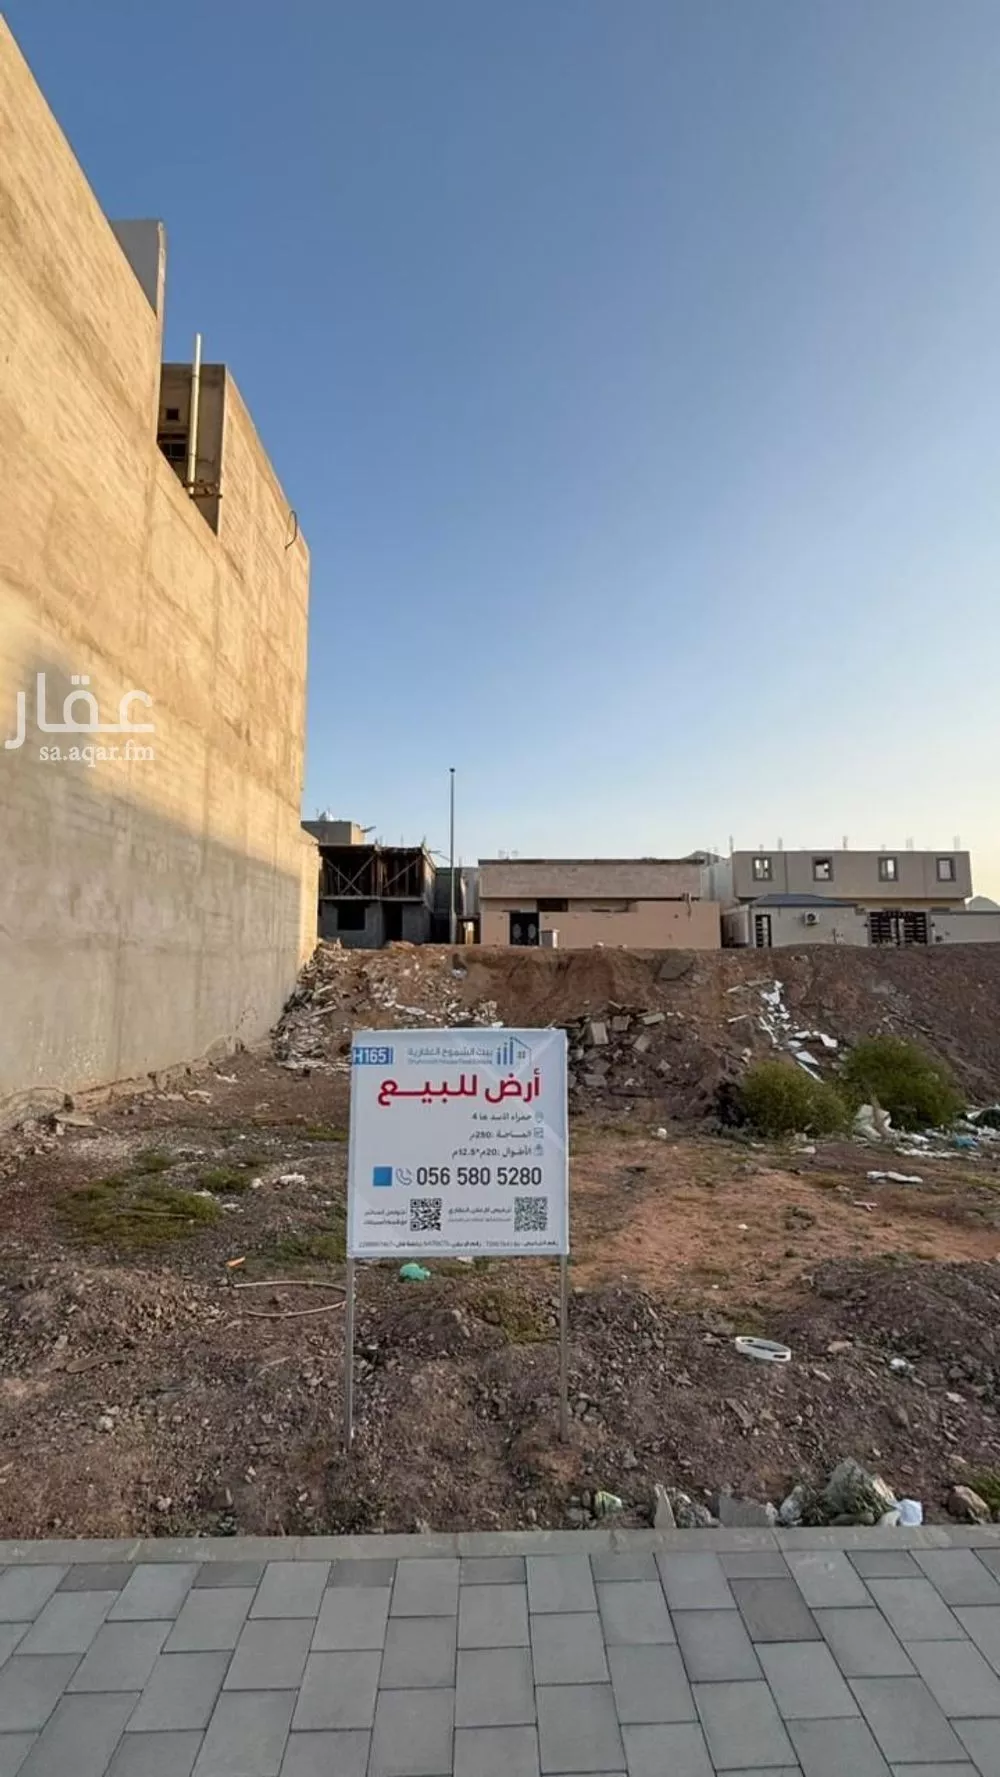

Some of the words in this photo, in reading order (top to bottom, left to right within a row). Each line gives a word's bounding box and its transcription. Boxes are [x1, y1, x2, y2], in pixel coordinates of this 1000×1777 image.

[352, 1048, 387, 1063] H165
[485, 1068, 541, 1103] أرض
[416, 1167, 450, 1186] 056
[457, 1167, 491, 1186] 580
[497, 1166, 542, 1186] 5280
